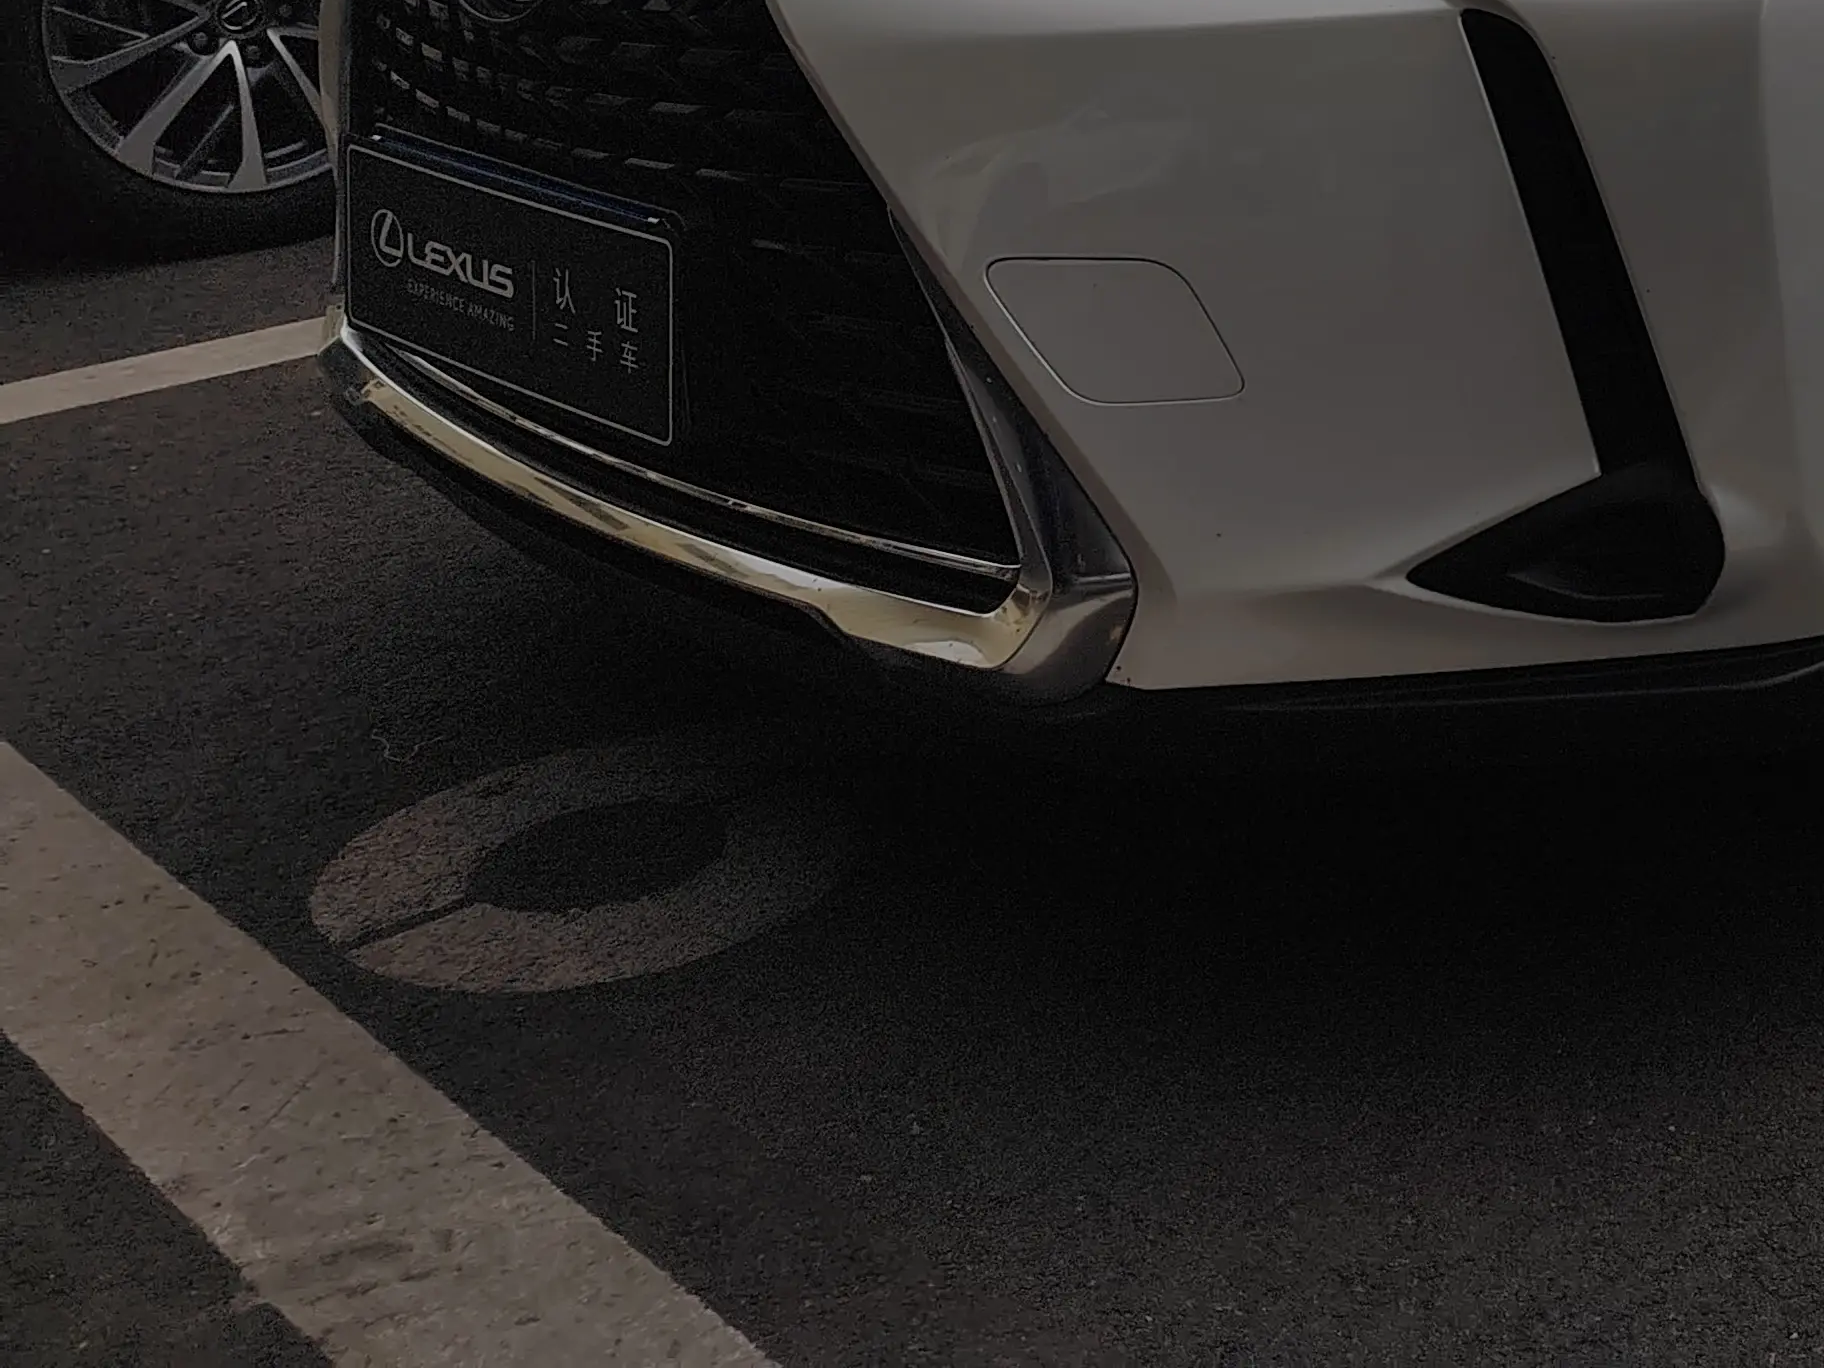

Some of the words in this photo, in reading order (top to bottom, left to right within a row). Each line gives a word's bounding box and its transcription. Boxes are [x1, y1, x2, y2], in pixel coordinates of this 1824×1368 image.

[407, 232, 515, 299] LEXUS
[552, 267, 640, 333] 认证
[552, 321, 640, 375] 二手车
